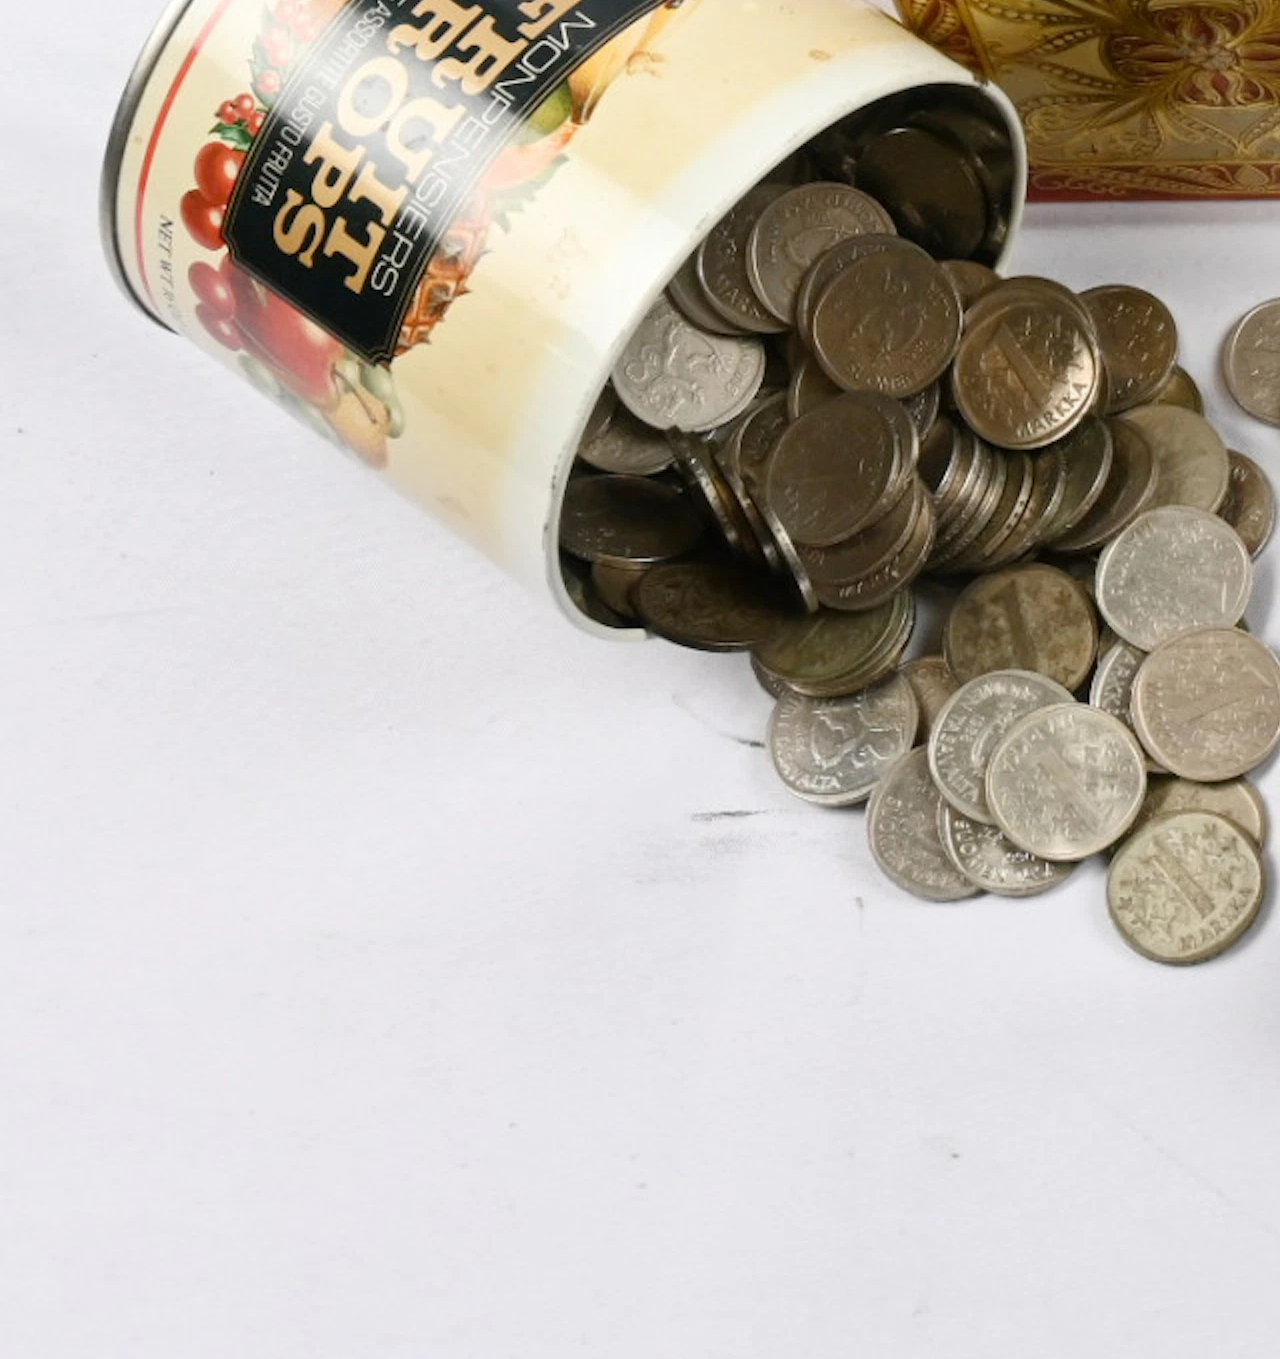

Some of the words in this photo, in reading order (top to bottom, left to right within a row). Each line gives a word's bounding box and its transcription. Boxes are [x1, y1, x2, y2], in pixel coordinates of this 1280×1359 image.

[280, 85, 328, 147] GUSTO
[250, 140, 295, 207] FRUTTA
[370, 9, 597, 298] MONPENSIERS
